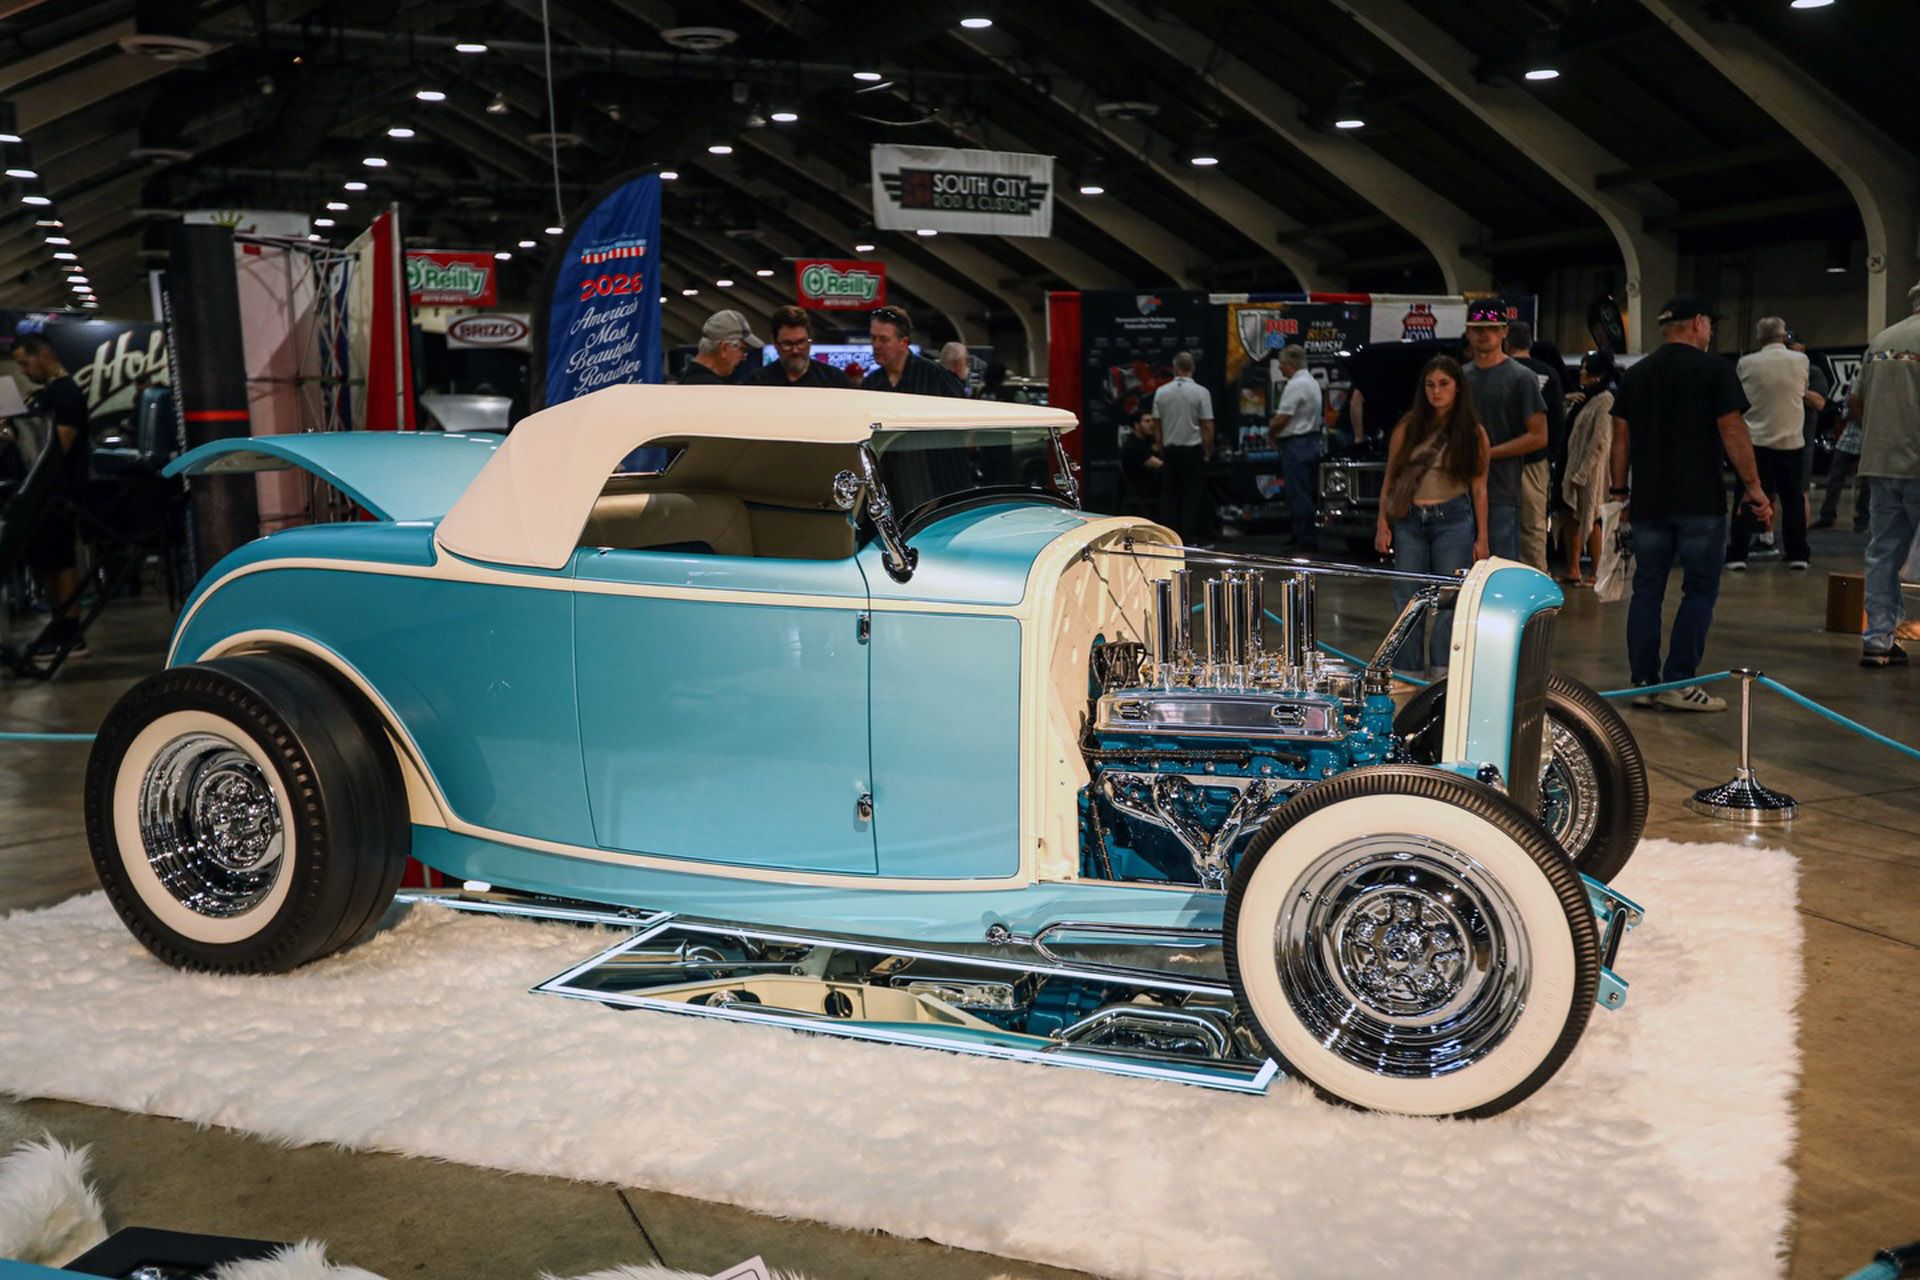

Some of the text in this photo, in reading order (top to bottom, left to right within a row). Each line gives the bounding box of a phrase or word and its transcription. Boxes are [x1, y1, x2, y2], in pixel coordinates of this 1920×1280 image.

[932, 173, 1029, 198] SOUTH CITY
[932, 194, 963, 208] ROD
[977, 196, 1029, 212] CUSTOM
[802, 265, 879, 300] O'Reilly
[459, 323, 518, 338] BRIZIO
[585, 319, 630, 350] Most
[1306, 327, 1338, 341] RUST
[565, 332, 640, 374] Beautiful
[1304, 340, 1344, 353] FINISH
[573, 359, 642, 392] Roadster
